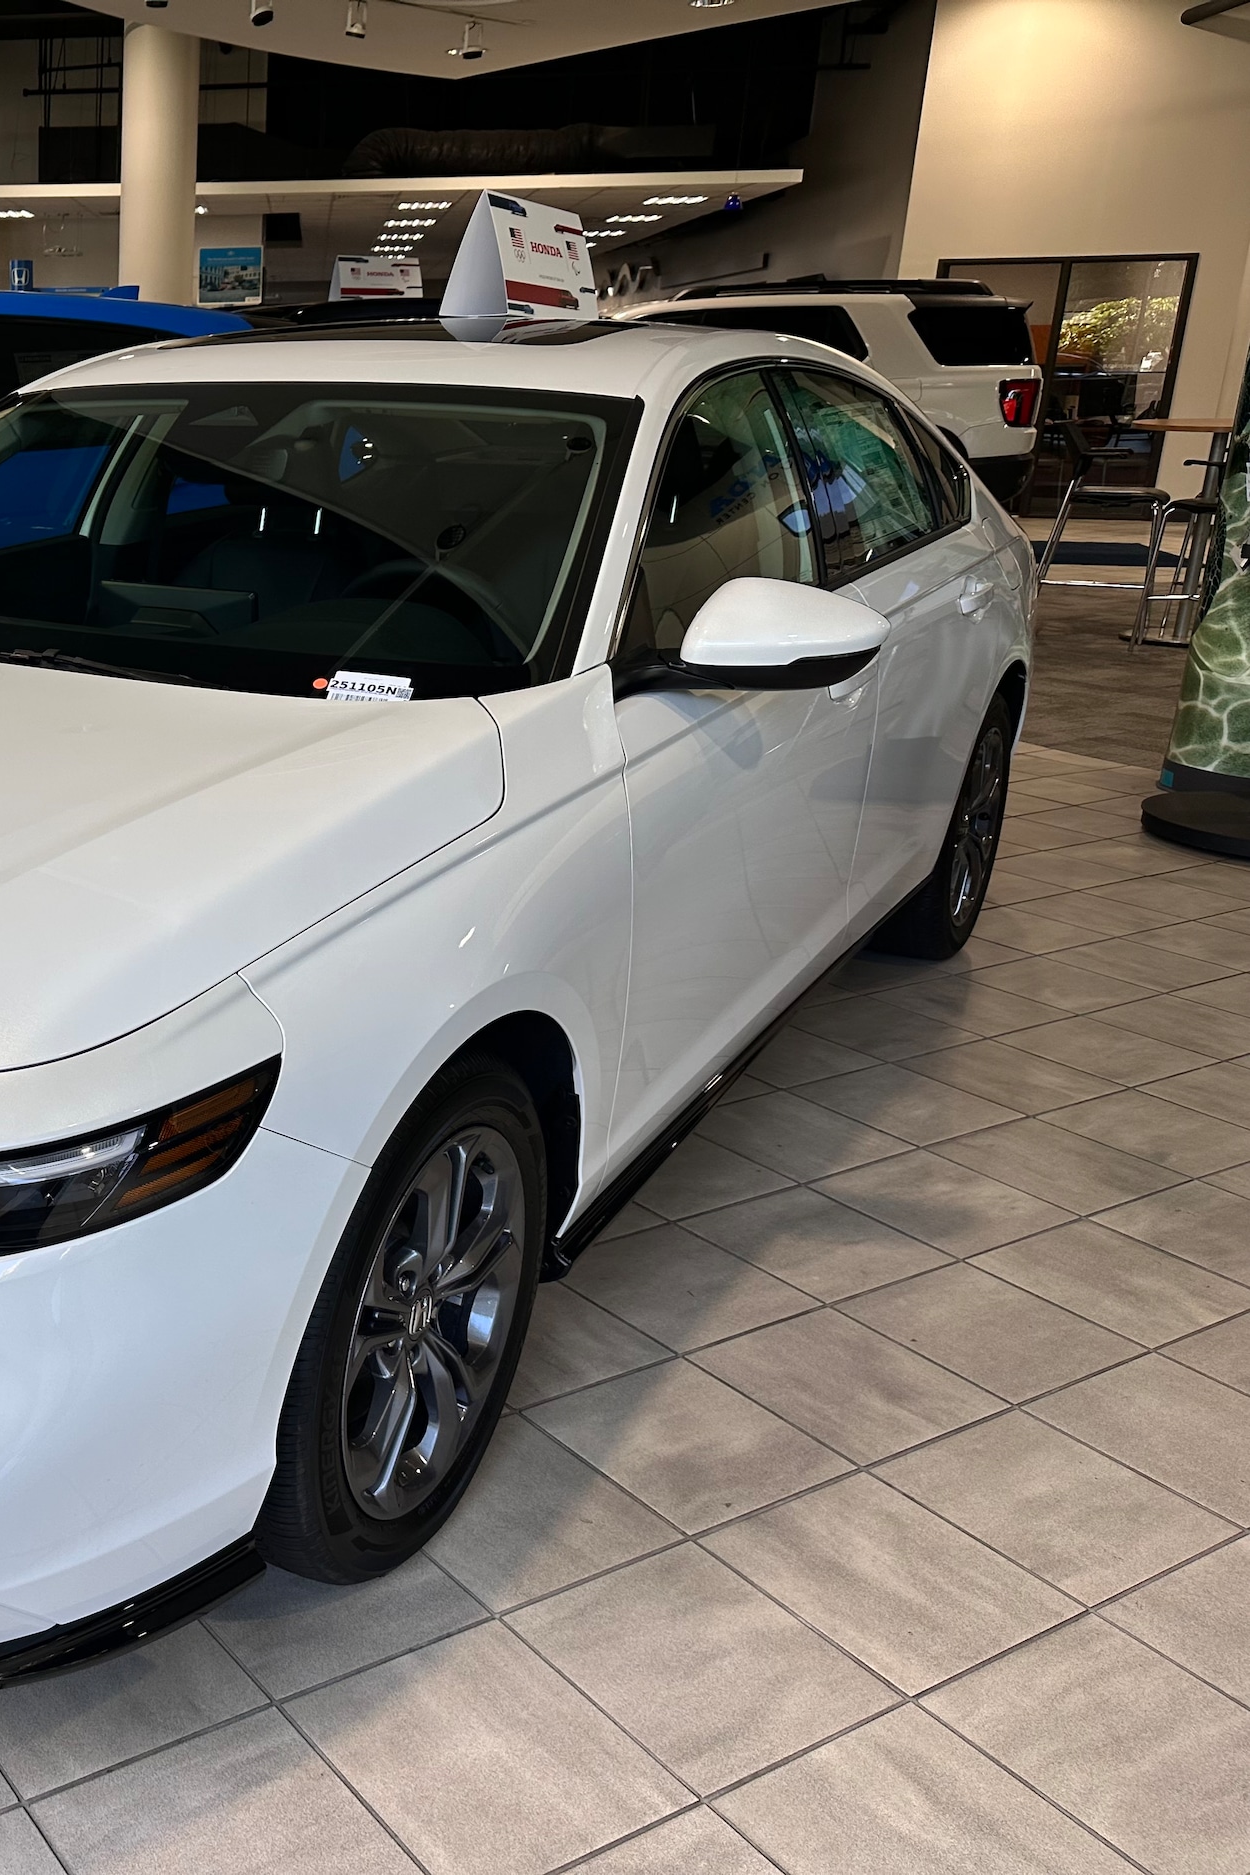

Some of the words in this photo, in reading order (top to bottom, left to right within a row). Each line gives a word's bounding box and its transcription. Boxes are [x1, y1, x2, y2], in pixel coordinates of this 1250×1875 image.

[530, 241, 563, 258] HONDA
[330, 679, 397, 695] 251105N
[320, 1388, 341, 1516] KINERGY
